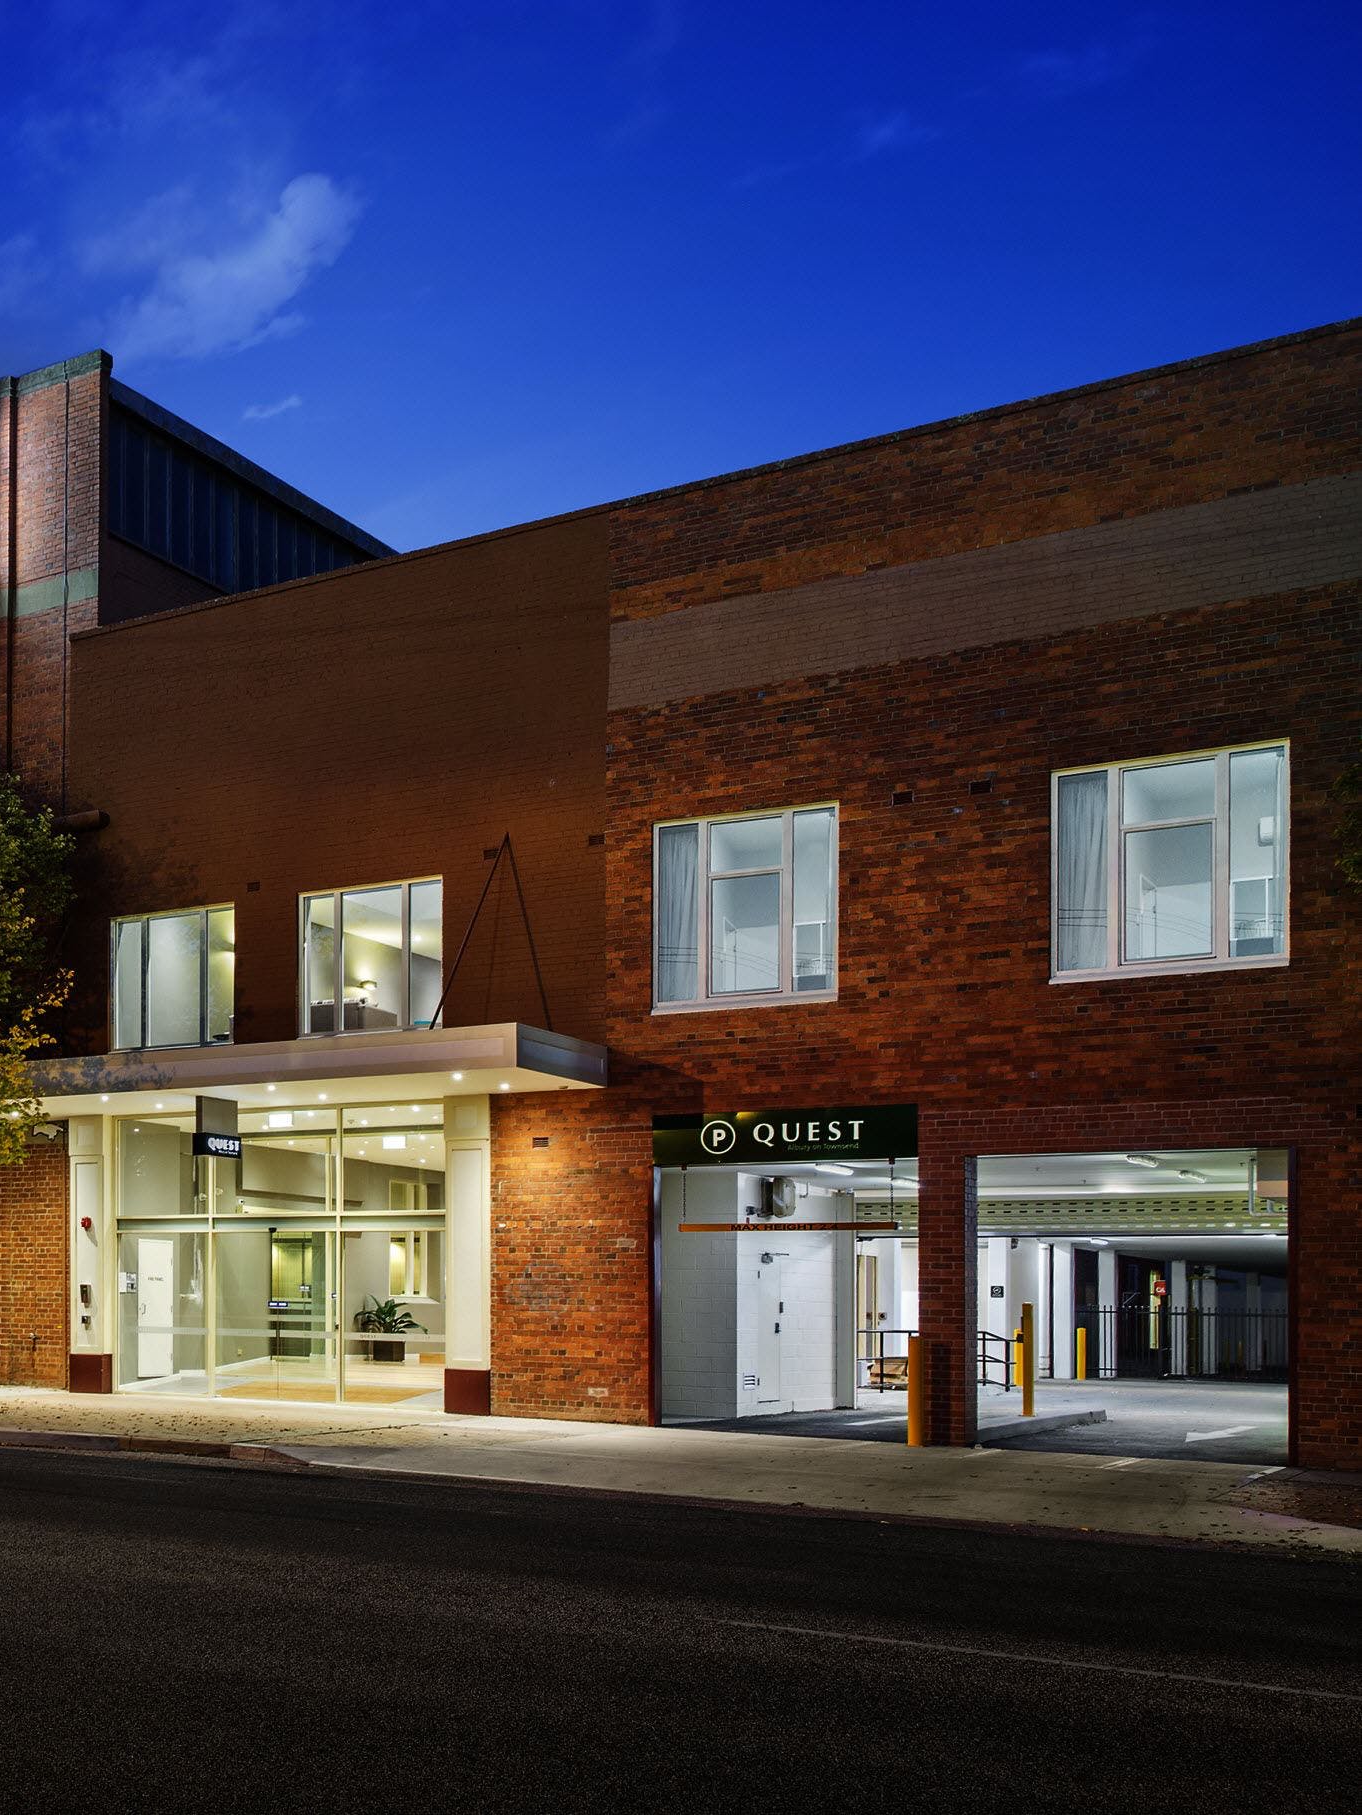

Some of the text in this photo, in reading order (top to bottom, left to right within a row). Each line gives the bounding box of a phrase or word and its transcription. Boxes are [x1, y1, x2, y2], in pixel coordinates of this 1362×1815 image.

[752, 1120, 864, 1147] QUEST
[208, 1137, 240, 1151] QUEST
[730, 1223, 759, 1231] MAX
[764, 1223, 814, 1231] HEIGHT
